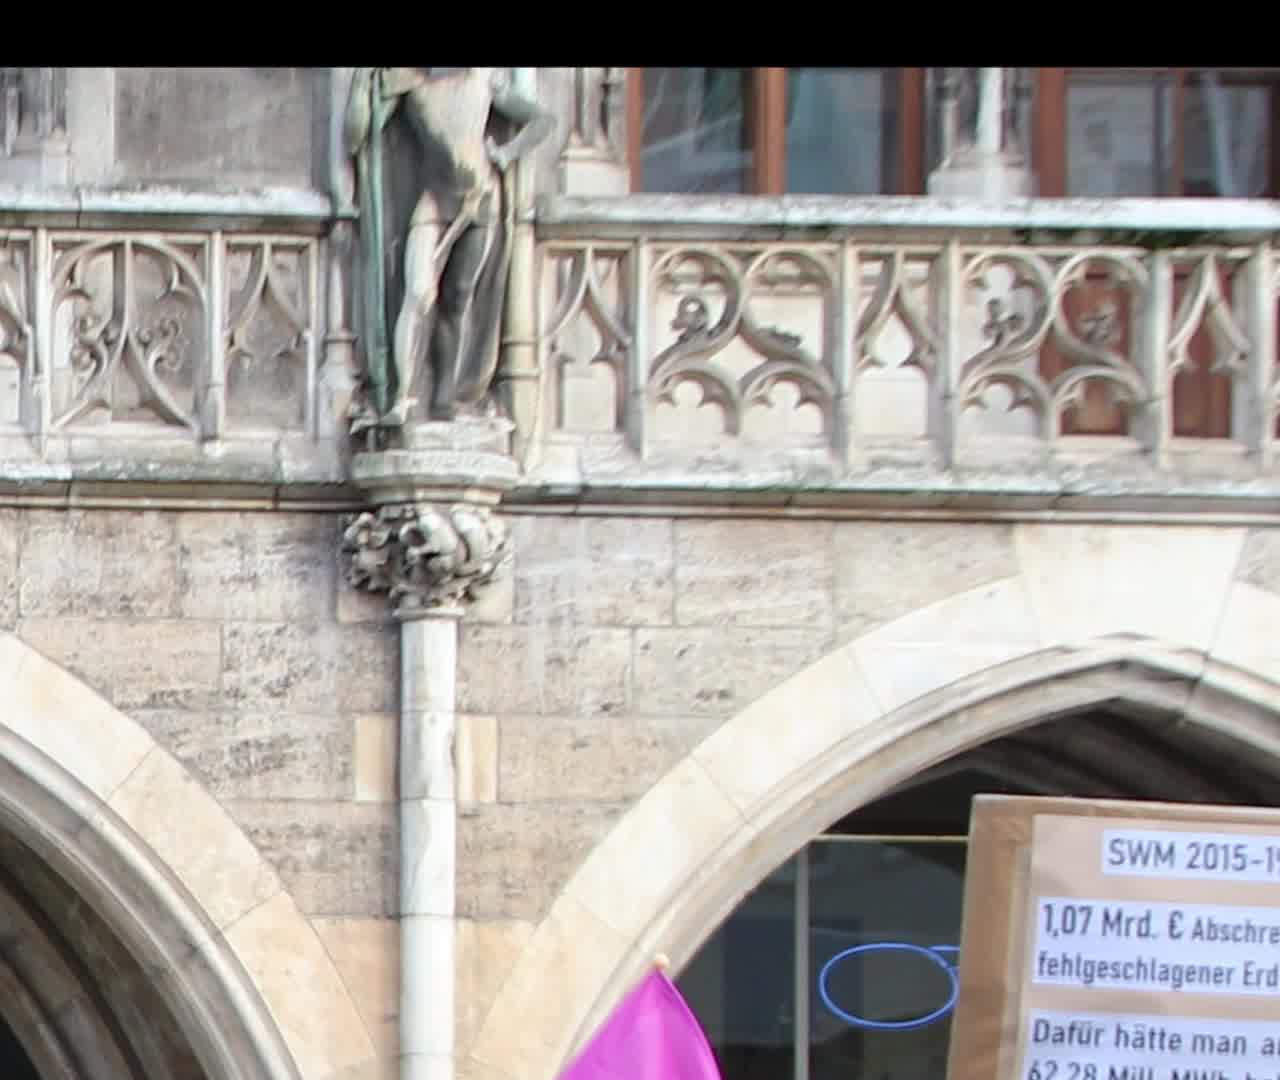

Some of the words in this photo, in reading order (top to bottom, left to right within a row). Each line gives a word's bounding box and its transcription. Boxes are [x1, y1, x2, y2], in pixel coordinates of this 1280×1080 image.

[1107, 837, 1176, 868] SWM
[1043, 903, 1092, 938] 1,07
[1101, 907, 1158, 941] Mrd.
[1167, 909, 1184, 940] €
[1037, 951, 1235, 991] fehlgeschlagener
[1243, 961, 1278, 988] Erd
[1032, 1018, 1104, 1047] Dafür
[1114, 1023, 1183, 1051] hätte
[1191, 1032, 1248, 1056] man
